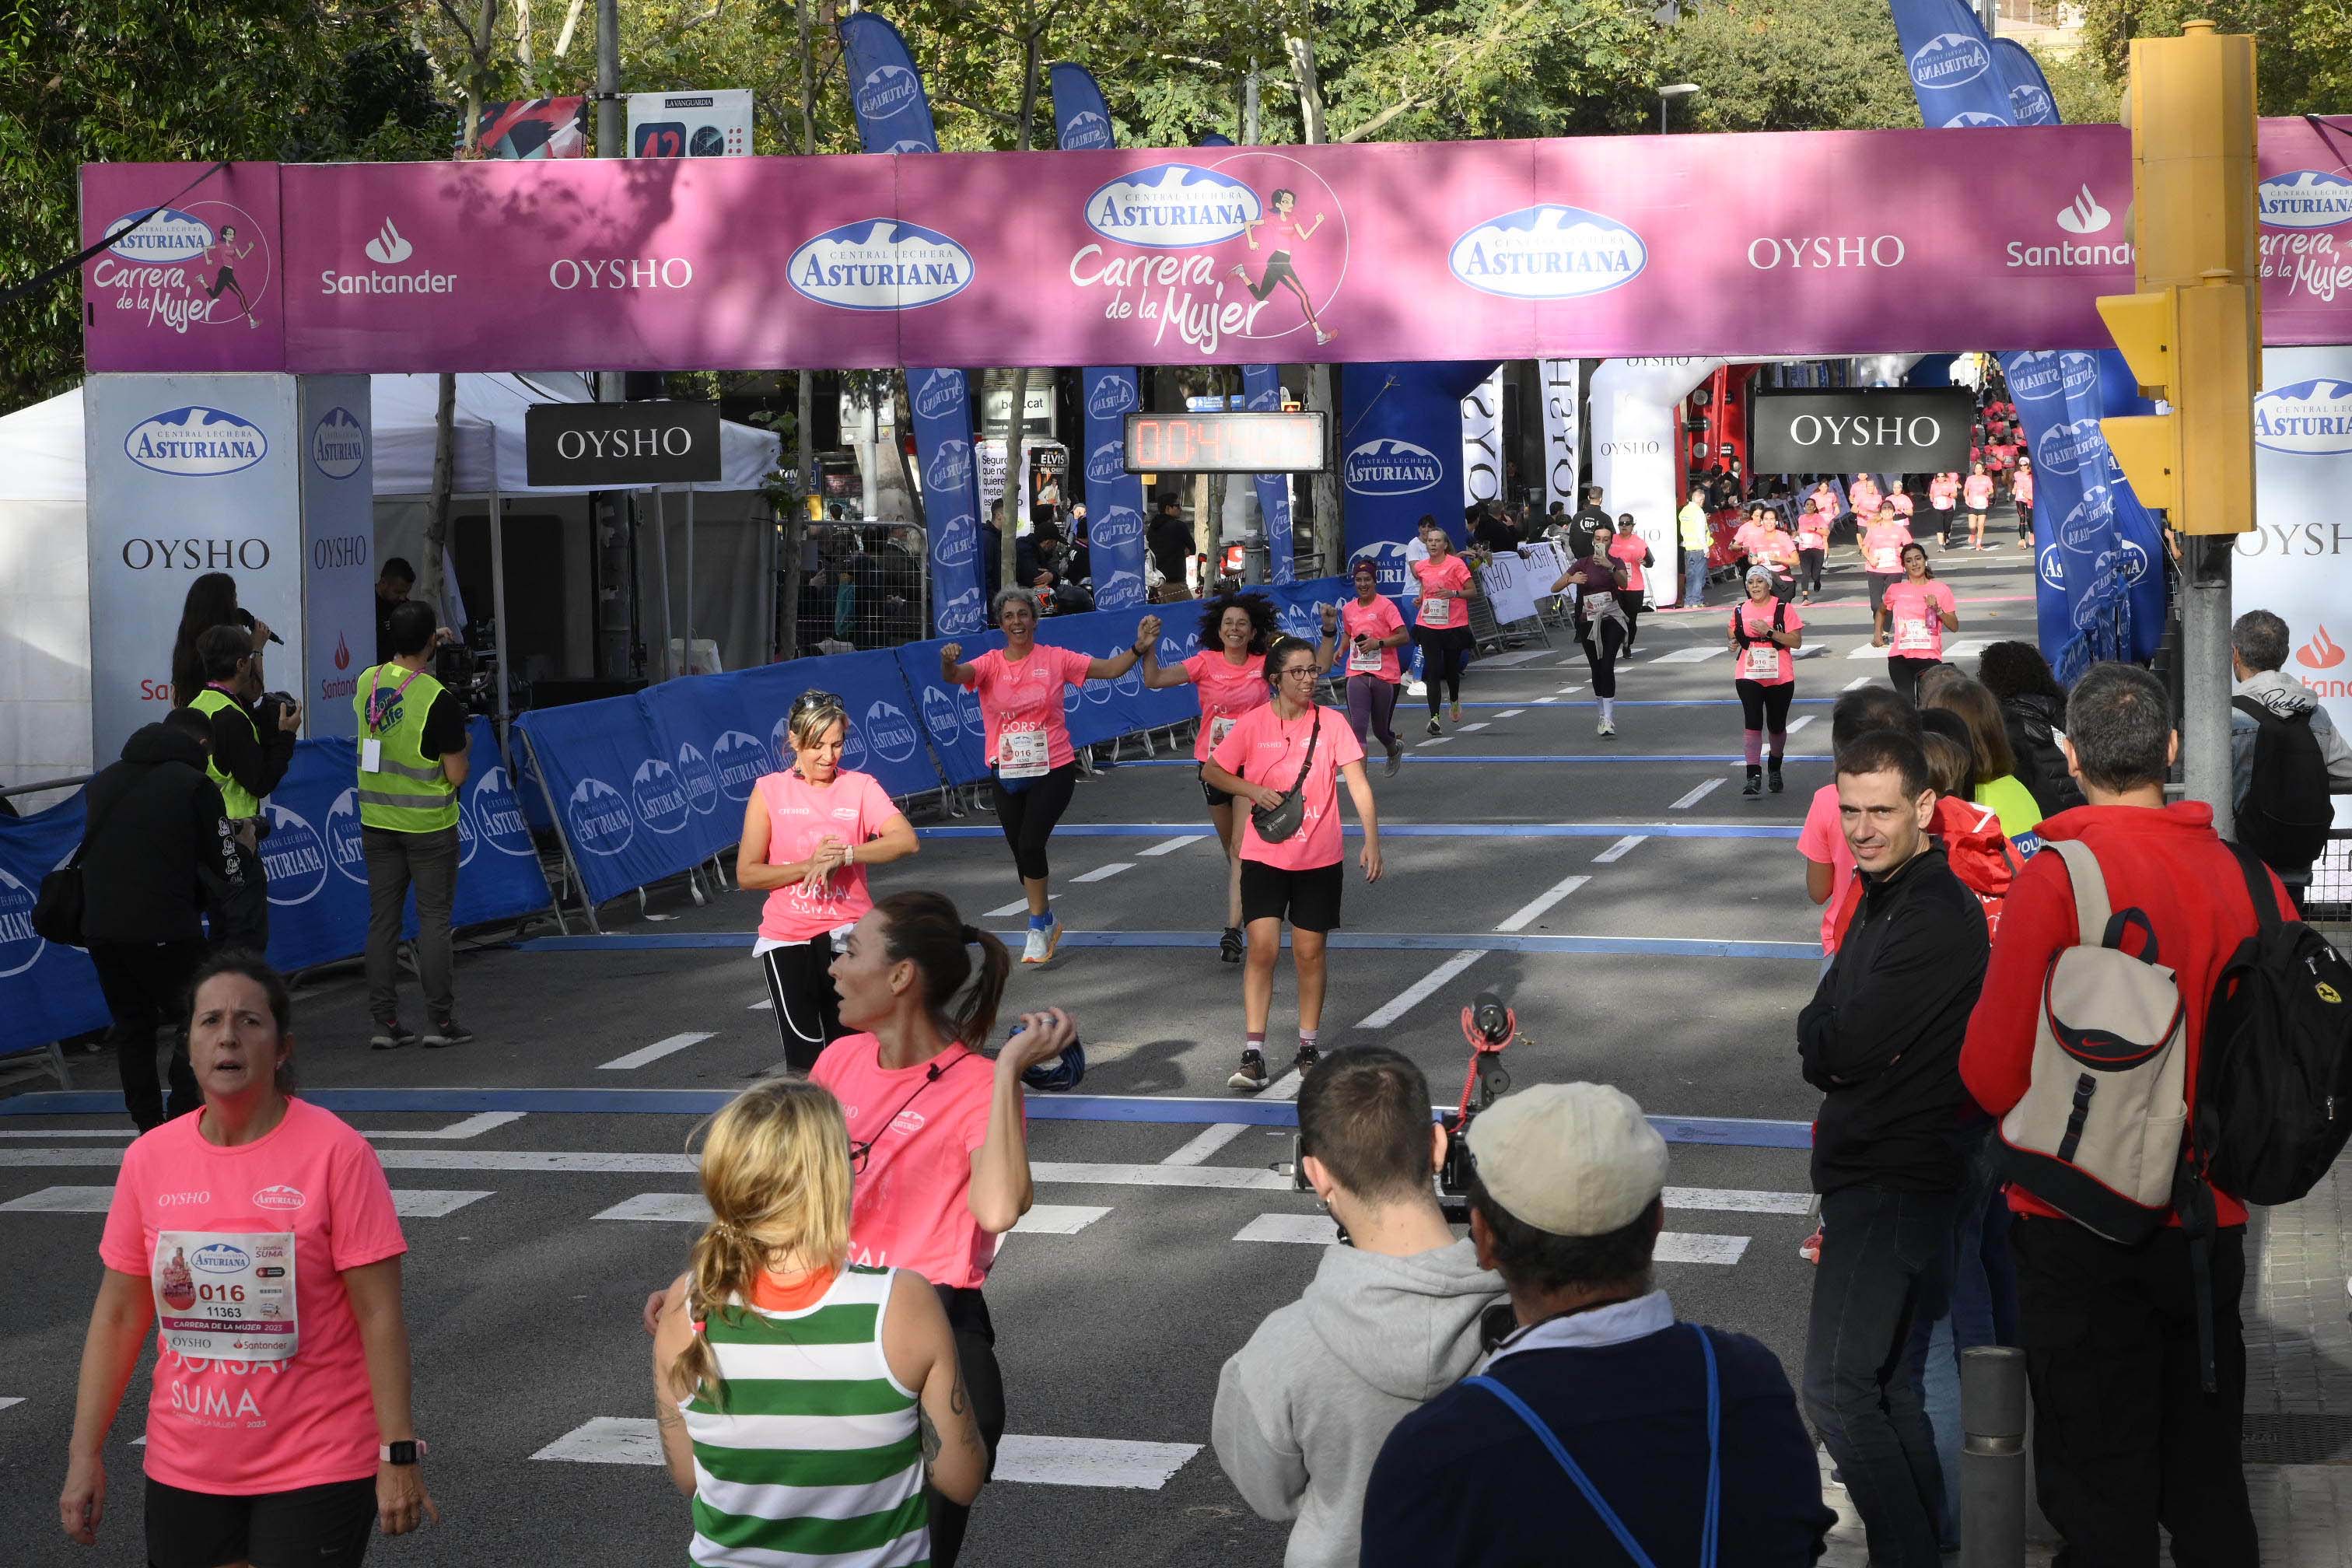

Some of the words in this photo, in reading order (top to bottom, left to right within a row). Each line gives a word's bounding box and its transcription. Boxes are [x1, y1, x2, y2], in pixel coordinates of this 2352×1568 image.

[673, 99, 712, 107] VANGUARDIA
[1185, 191, 1243, 200] LECHERA
[1098, 195, 1247, 227] ASTURIANA
[830, 251, 888, 260] CENTRAL
[894, 249, 954, 258] LECHERA
[1465, 241, 1631, 275] ASTURIANA
[1748, 235, 1906, 270] OYSHO
[2007, 242, 2136, 267] Santand
[93, 259, 184, 289] Carrera
[550, 258, 693, 290] OYSHO
[801, 254, 960, 287] ASTURIANA
[1069, 243, 1215, 288] Carrera
[2278, 256, 2292, 278] la
[321, 269, 457, 295] Santander
[117, 289, 134, 310] de
[137, 293, 149, 310] la
[147, 285, 220, 334] Mujer
[1105, 289, 1132, 320] de
[1139, 289, 1157, 320] la
[1153, 281, 1270, 355] Mujer
[2277, 405, 2329, 415] CENTRAL
[557, 427, 692, 460] OYSHO
[1790, 415, 1941, 447] OYSHO
[136, 432, 258, 459] ASTURIANA
[317, 434, 362, 461] ASTURIANA
[1601, 441, 1659, 456] OYSHO
[1041, 454, 1065, 464] ELVIS
[983, 467, 996, 477] que
[983, 477, 1006, 487] quiere
[1348, 462, 1435, 483] ASTURIANA
[122, 538, 271, 570] OYSHO
[315, 535, 366, 570] OYSHO
[322, 675, 356, 700] Santand
[963, 702, 983, 724] ASTUR
[158, 1191, 211, 1207] OYSHO
[256, 1194, 303, 1206] ASTURIANA
[195, 1254, 246, 1267] ASTURIANA
[199, 1284, 245, 1302] 016
[206, 1307, 242, 1318] 11363
[173, 1337, 212, 1349] OYSHO
[244, 1341, 287, 1350] Santander
[171, 1380, 261, 1418] SUMA
